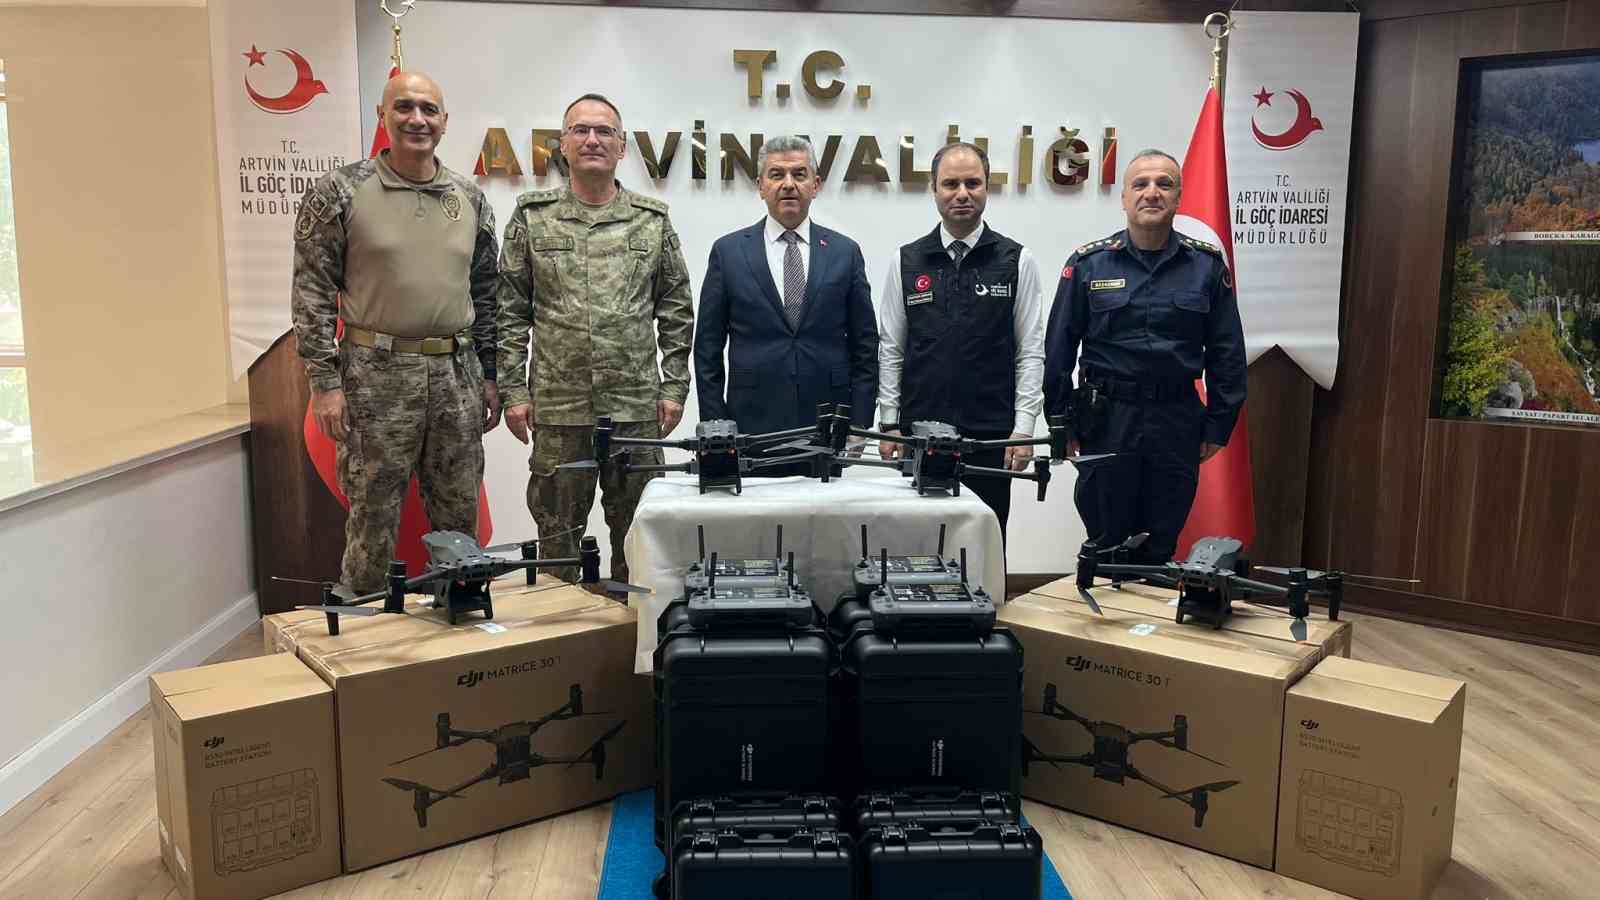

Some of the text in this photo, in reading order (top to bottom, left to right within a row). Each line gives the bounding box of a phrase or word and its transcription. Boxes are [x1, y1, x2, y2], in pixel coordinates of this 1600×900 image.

[733, 49, 871, 100] T.C.
[281, 140, 300, 154] T.C.
[473, 119, 763, 180] ARVİN
[240, 156, 286, 171] ARTVİN
[240, 172, 254, 193] İL
[257, 173, 286, 198] GÖÇ
[1237, 187, 1330, 204] ARTVİN VALİLİĞİ
[1235, 205, 1329, 229] İL GÖÇ İDARESİ
[1234, 227, 1328, 244] MÜDÜRLÜĞÜ
[487, 660, 537, 680] MATRICE
[540, 656, 554, 669] 30
[1094, 662, 1143, 682] MATRICE
[1145, 673, 1161, 686] 30
